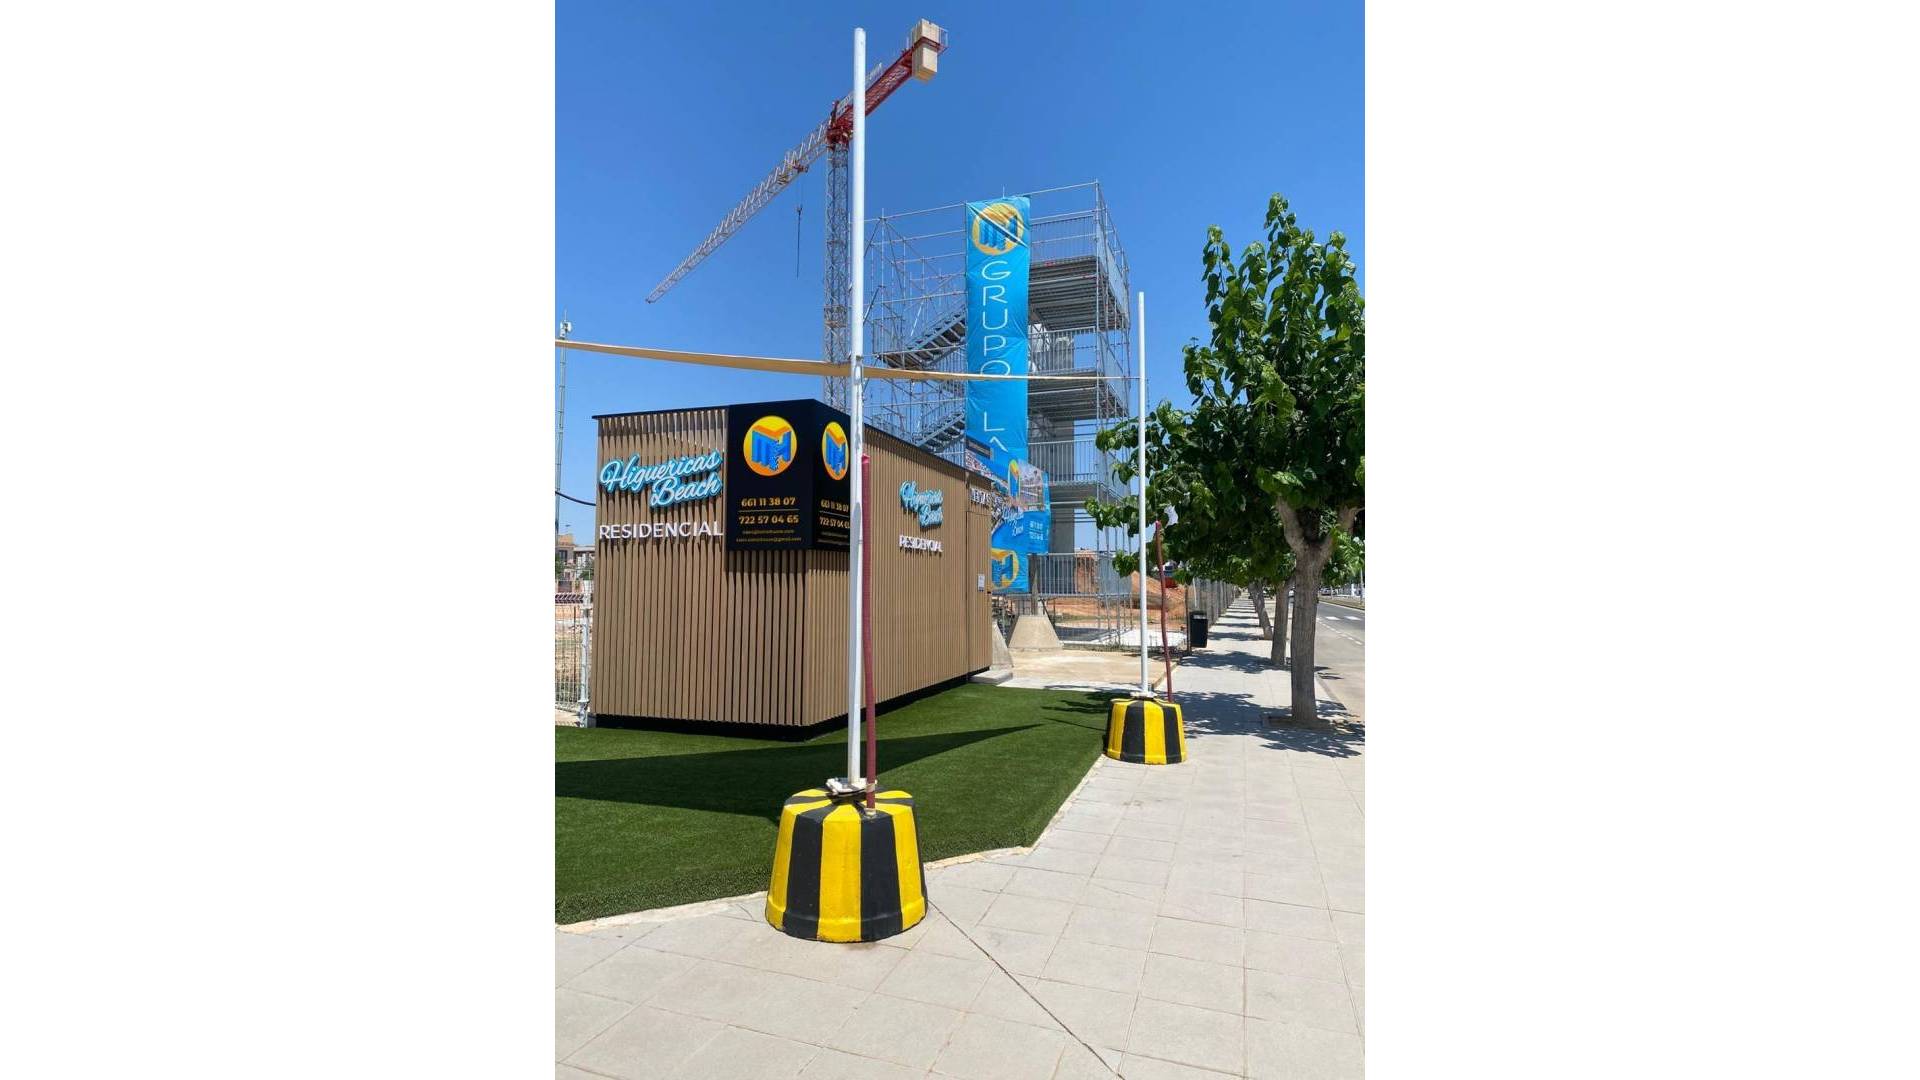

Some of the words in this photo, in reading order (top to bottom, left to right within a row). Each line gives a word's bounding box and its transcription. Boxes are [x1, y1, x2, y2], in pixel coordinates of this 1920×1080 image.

[980, 260, 1012, 378] GRUPO
[600, 452, 722, 494] Higuericas
[650, 472, 723, 507] Beach
[741, 498, 757, 507] 661
[760, 498, 767, 507] 11
[769, 497, 781, 506] 38
[783, 497, 796, 506] 07
[599, 521, 724, 539] RESIDENCIAL
[739, 516, 756, 525] 722
[758, 516, 770, 525] 57
[772, 515, 784, 524] 04
[787, 515, 800, 524] 65
